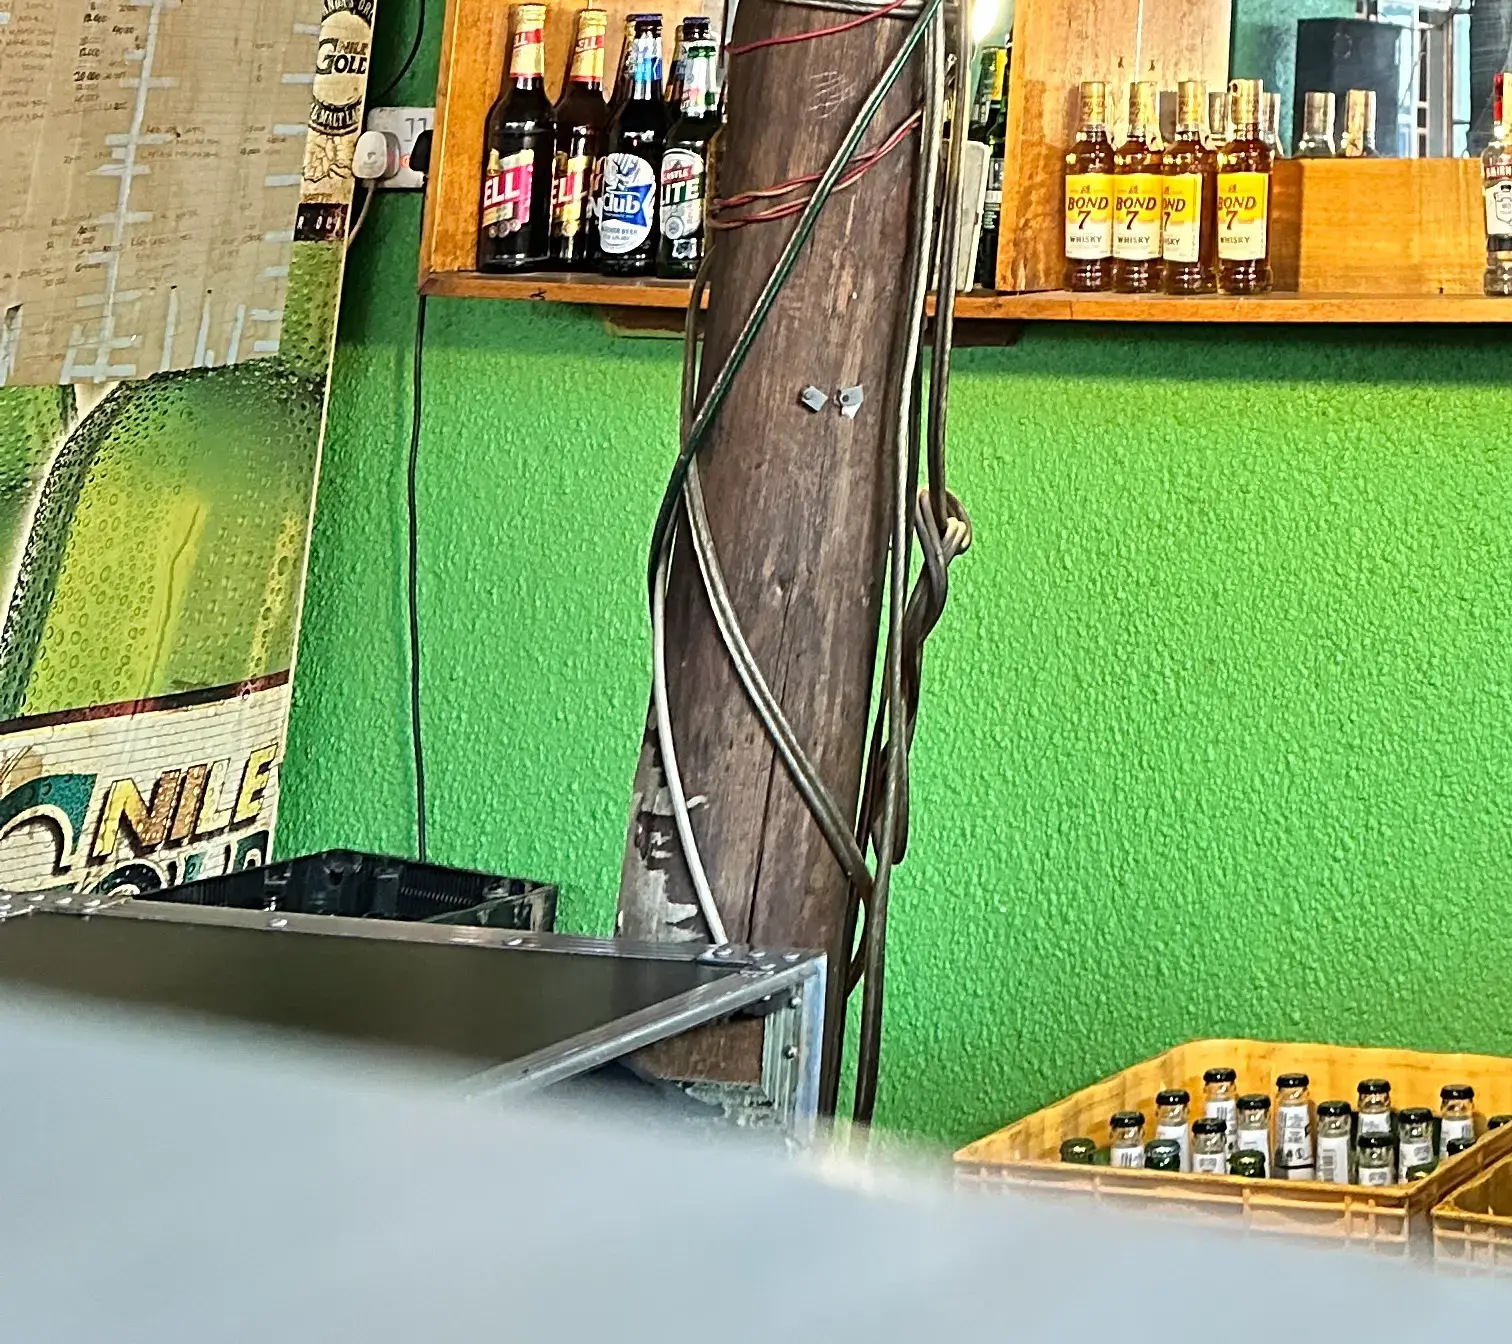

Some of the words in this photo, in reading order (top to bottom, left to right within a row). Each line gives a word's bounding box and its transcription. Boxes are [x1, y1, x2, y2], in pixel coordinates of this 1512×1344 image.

[319, 110, 344, 128] MALT
[484, 172, 521, 208] ELL
[603, 192, 641, 214] Club
[1067, 196, 1109, 212] BOND
[1115, 196, 1157, 212] BOND
[1077, 211, 1091, 230] 7
[1126, 211, 1139, 230] 7
[1225, 211, 1240, 230] 7
[1069, 235, 1102, 244] WHISKY
[1117, 236, 1150, 245] WHISKY
[90, 743, 280, 867] NILE
